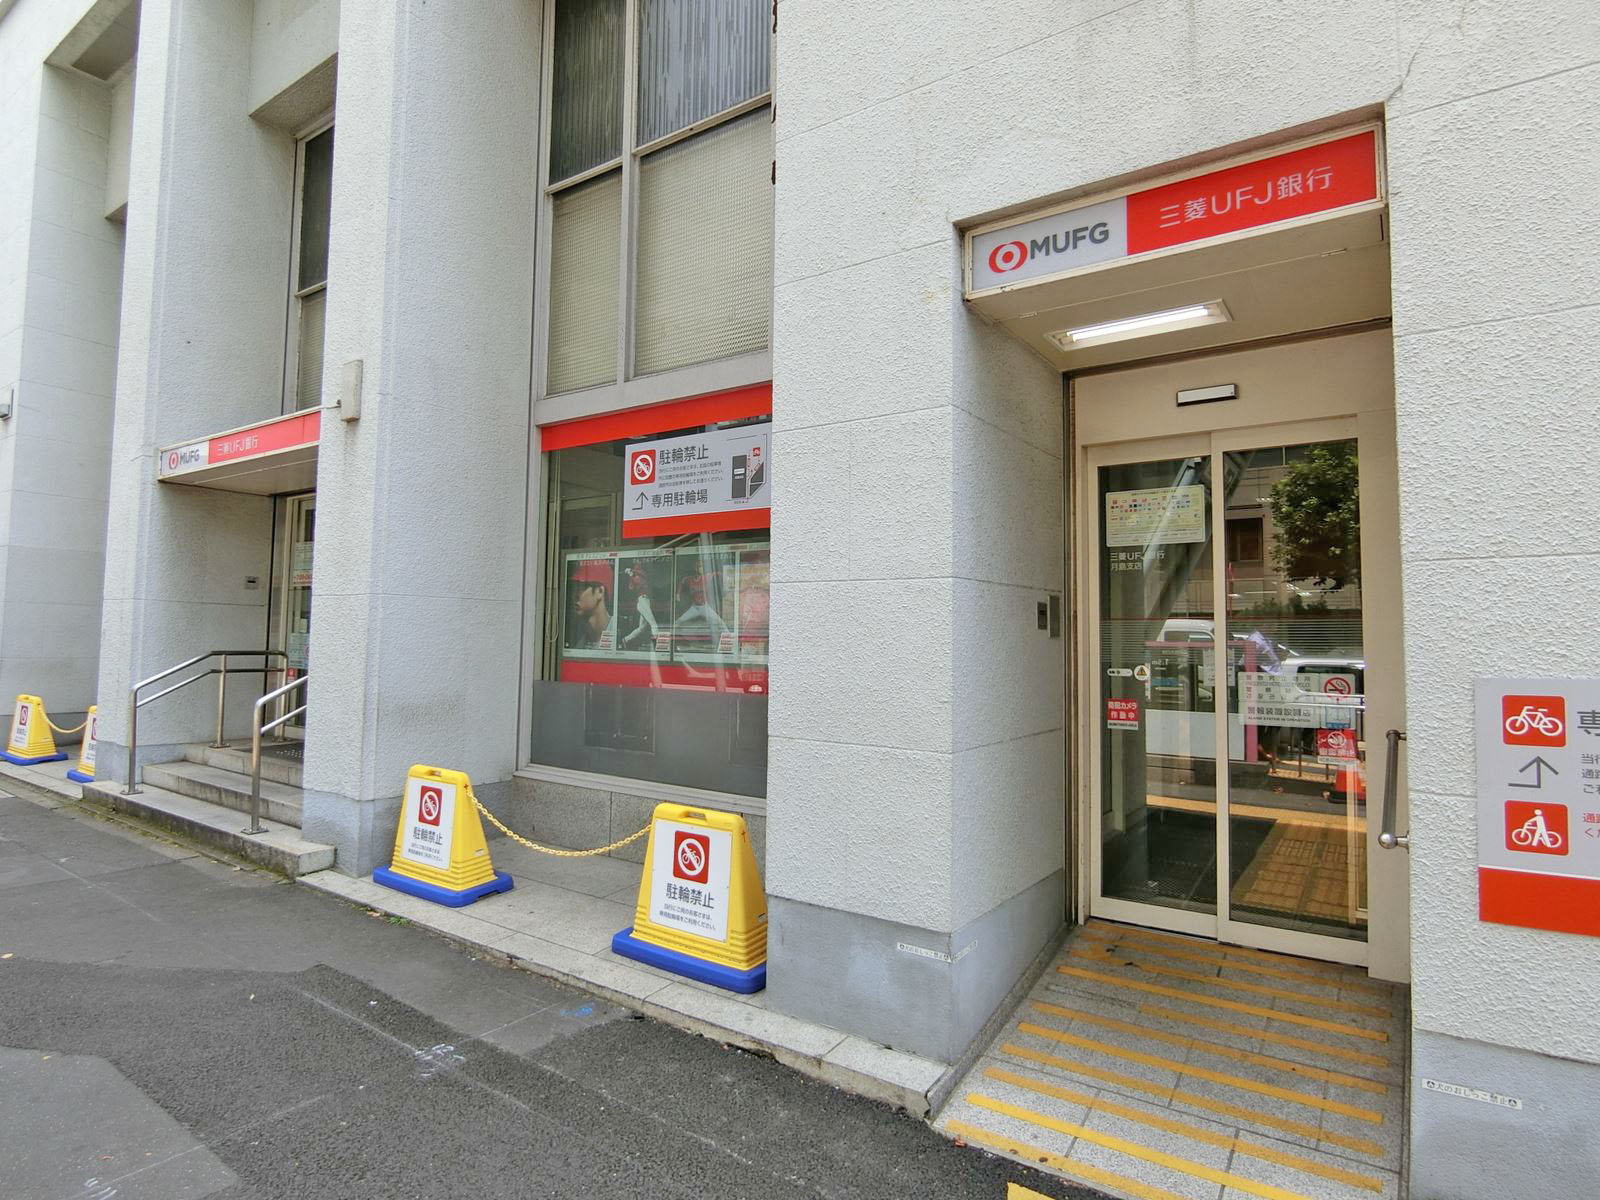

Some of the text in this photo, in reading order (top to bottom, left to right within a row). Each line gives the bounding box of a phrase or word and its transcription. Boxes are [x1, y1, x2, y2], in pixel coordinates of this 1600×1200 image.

[1159, 166, 1334, 229] 三菱UFJ銀行
[1029, 222, 1109, 260] MUFG
[217, 435, 258, 456] 三菱UFJ銀行
[659, 444, 709, 466] 駐輪禁止
[180, 449, 200, 466] MUFG
[651, 489, 708, 508] 専用駐輪場
[1110, 550, 1166, 561] 三菱UF行
[1108, 701, 1137, 710] 防犯カメラ
[1111, 711, 1135, 719] 作動中
[413, 826, 443, 846] 駐輪禁止
[666, 883, 715, 909] 駐輪禁止
[1436, 1083, 1508, 1105] 犬のおしっこ禁止
